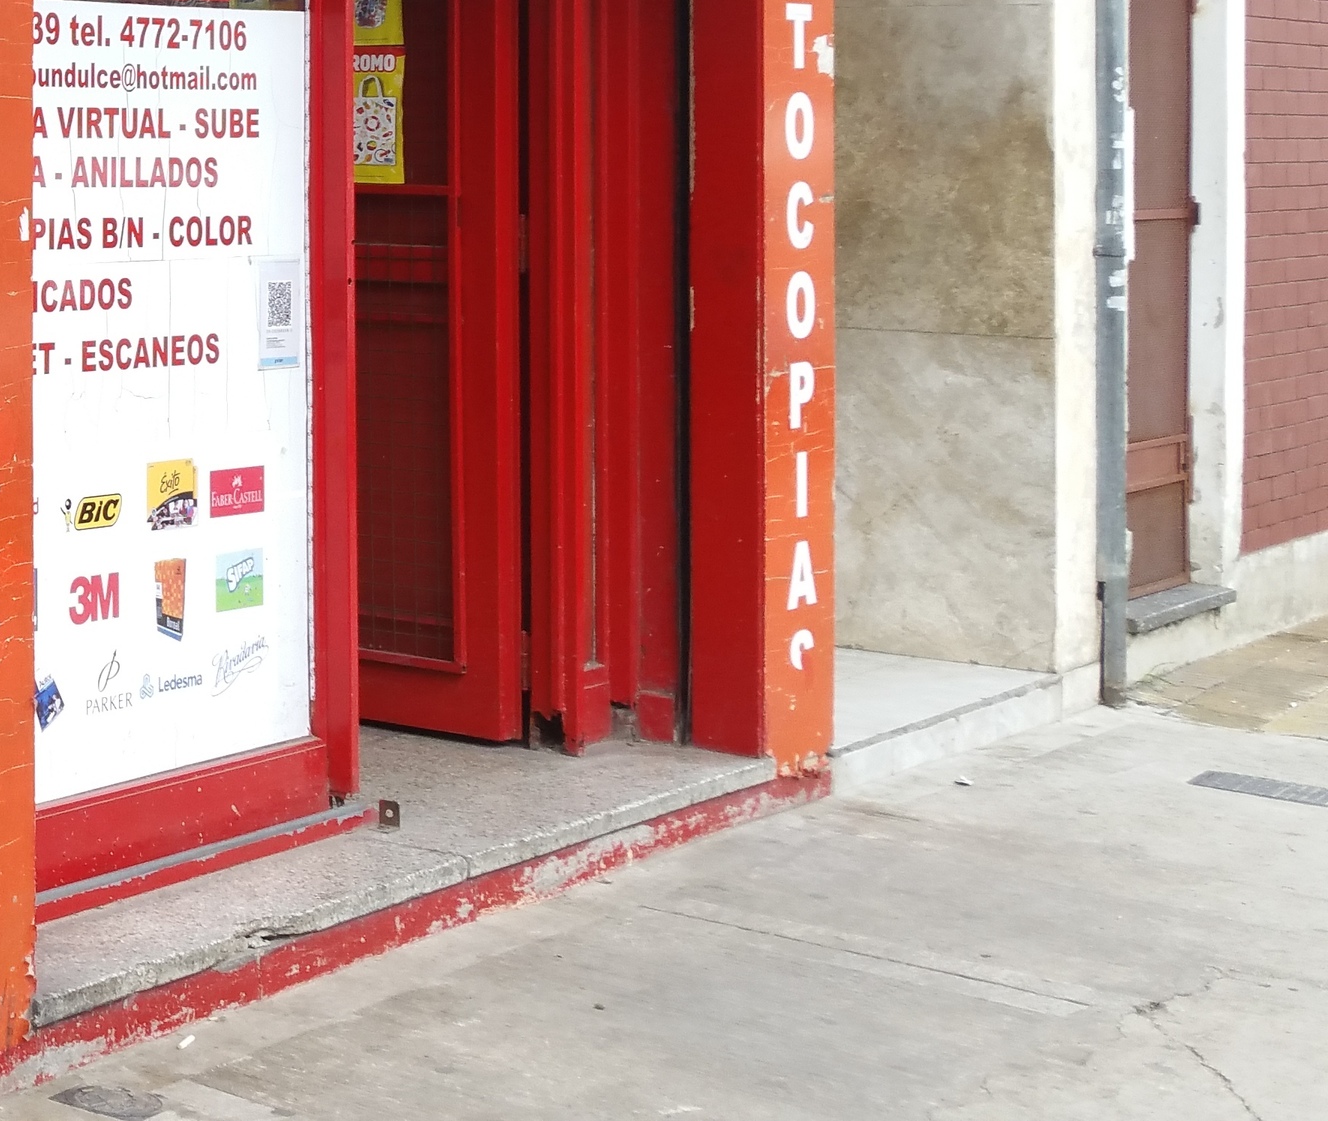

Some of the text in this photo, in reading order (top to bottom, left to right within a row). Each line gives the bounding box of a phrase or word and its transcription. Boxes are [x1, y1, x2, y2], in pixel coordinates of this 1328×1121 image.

[69, 14, 111, 47] tel.
[120, 15, 248, 51] 4772-7106
[57, 107, 172, 139] VIRTUAL
[194, 108, 260, 139] SUBE
[71, 156, 219, 188] ANILLADOS
[33, 217, 93, 250] PIAS
[102, 216, 144, 249] B/N
[169, 215, 253, 248] COLOR
[82, 333, 220, 372] ESCANEOS
[68, 571, 120, 625] 3M
[158, 672, 203, 693] Ledesma
[85, 692, 133, 716] PARKER
